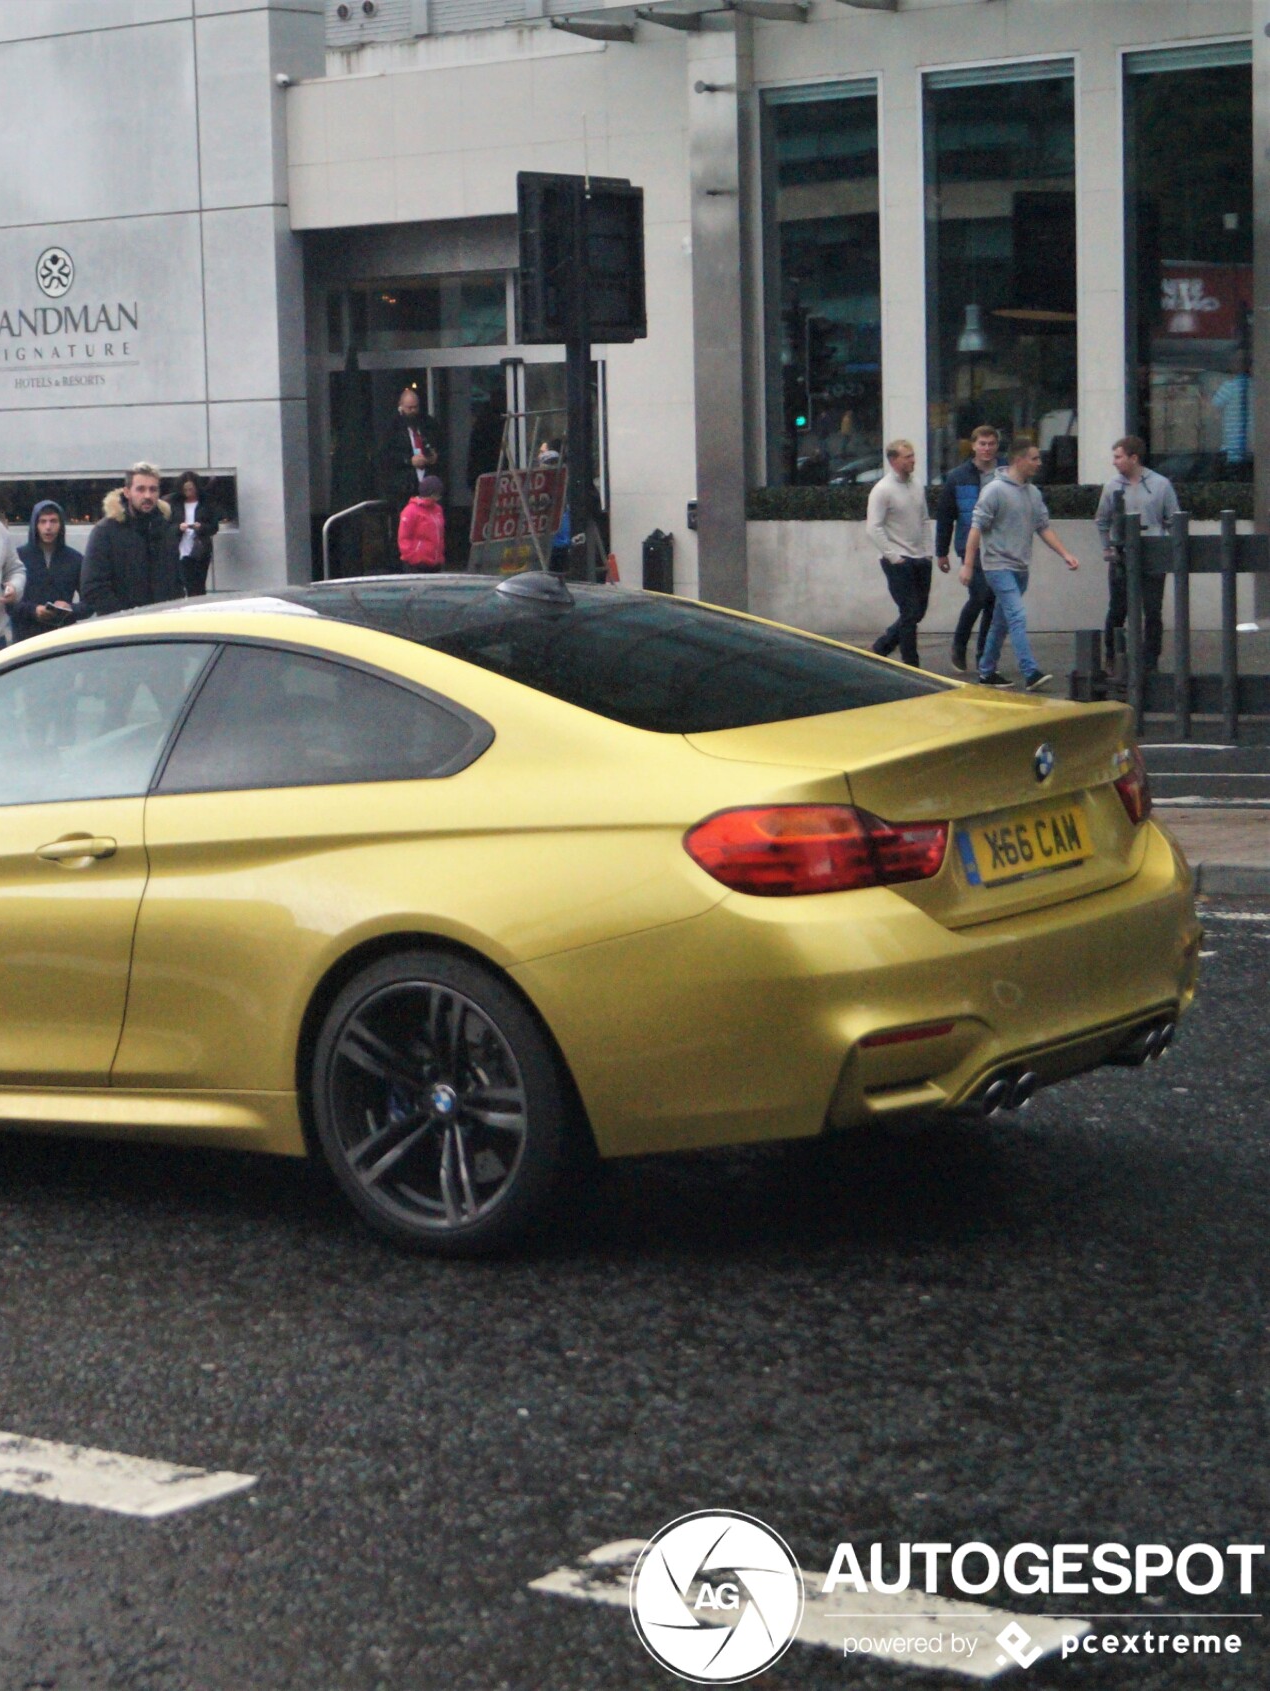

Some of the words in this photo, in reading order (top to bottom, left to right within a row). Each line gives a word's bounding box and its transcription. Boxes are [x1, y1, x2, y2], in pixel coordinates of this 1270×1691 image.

[14, 377, 52, 389] HOTELS
[62, 374, 106, 388] RESORTS
[1034, 812, 1082, 858] CAM
